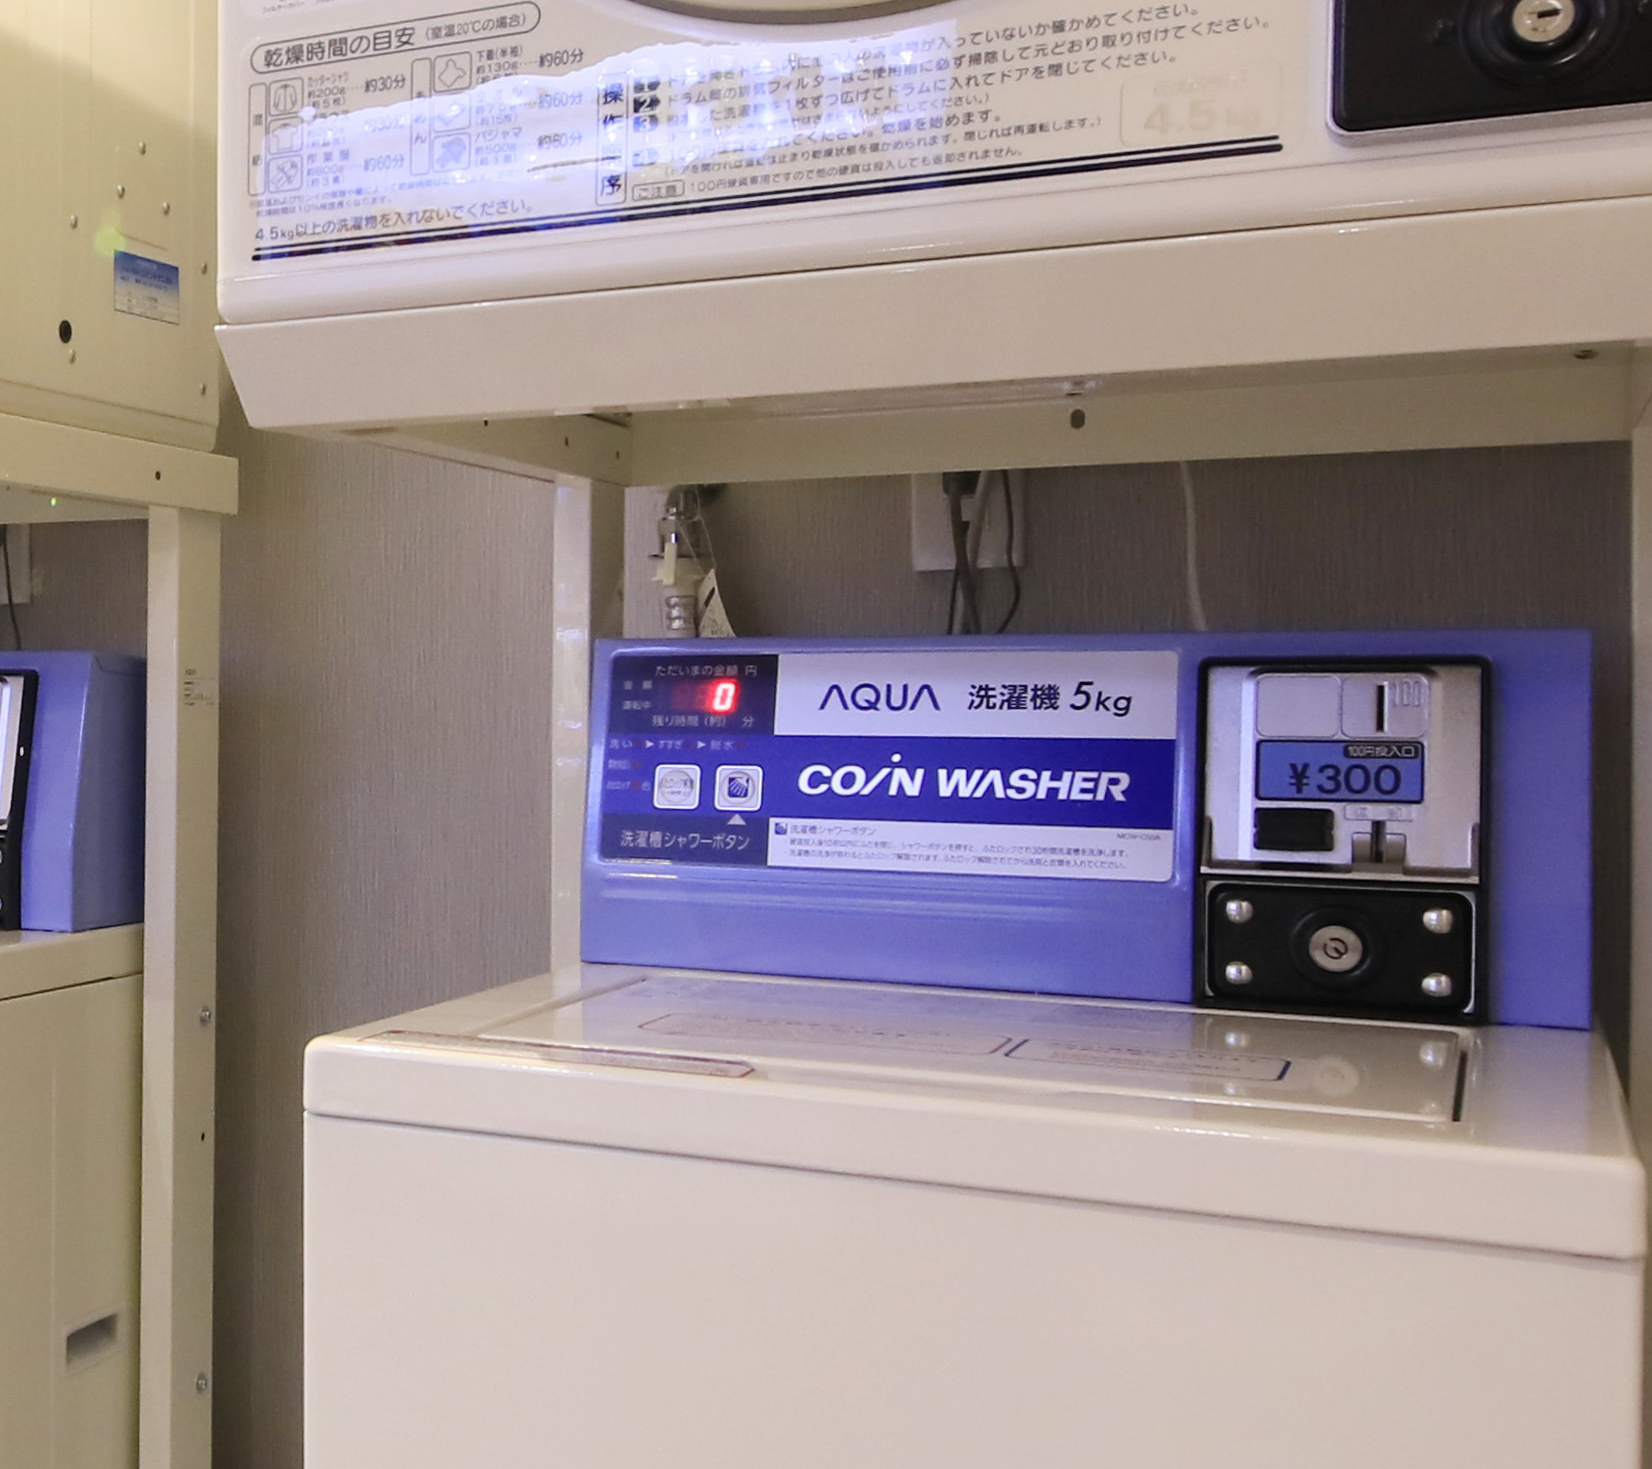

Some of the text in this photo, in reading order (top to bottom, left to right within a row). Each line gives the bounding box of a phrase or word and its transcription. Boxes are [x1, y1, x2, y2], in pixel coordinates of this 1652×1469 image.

[263, 26, 416, 69] 乾燥時間の目安
[538, 47, 585, 69] 約60分
[363, 73, 407, 94] 約30分
[474, 126, 523, 143] パジャマ
[638, 183, 678, 200] ご注意
[745, 664, 758, 678] 円
[712, 682, 736, 712] 0
[818, 681, 1133, 717] AQUA 洗濯機 5kg
[742, 715, 755, 728] 分
[1347, 745, 1416, 758] 100円投入口
[797, 753, 1131, 802] COIN WASHER
[1288, 762, 1402, 797] ¥300
[620, 830, 751, 851] 洗濯槽シャワーボタン
